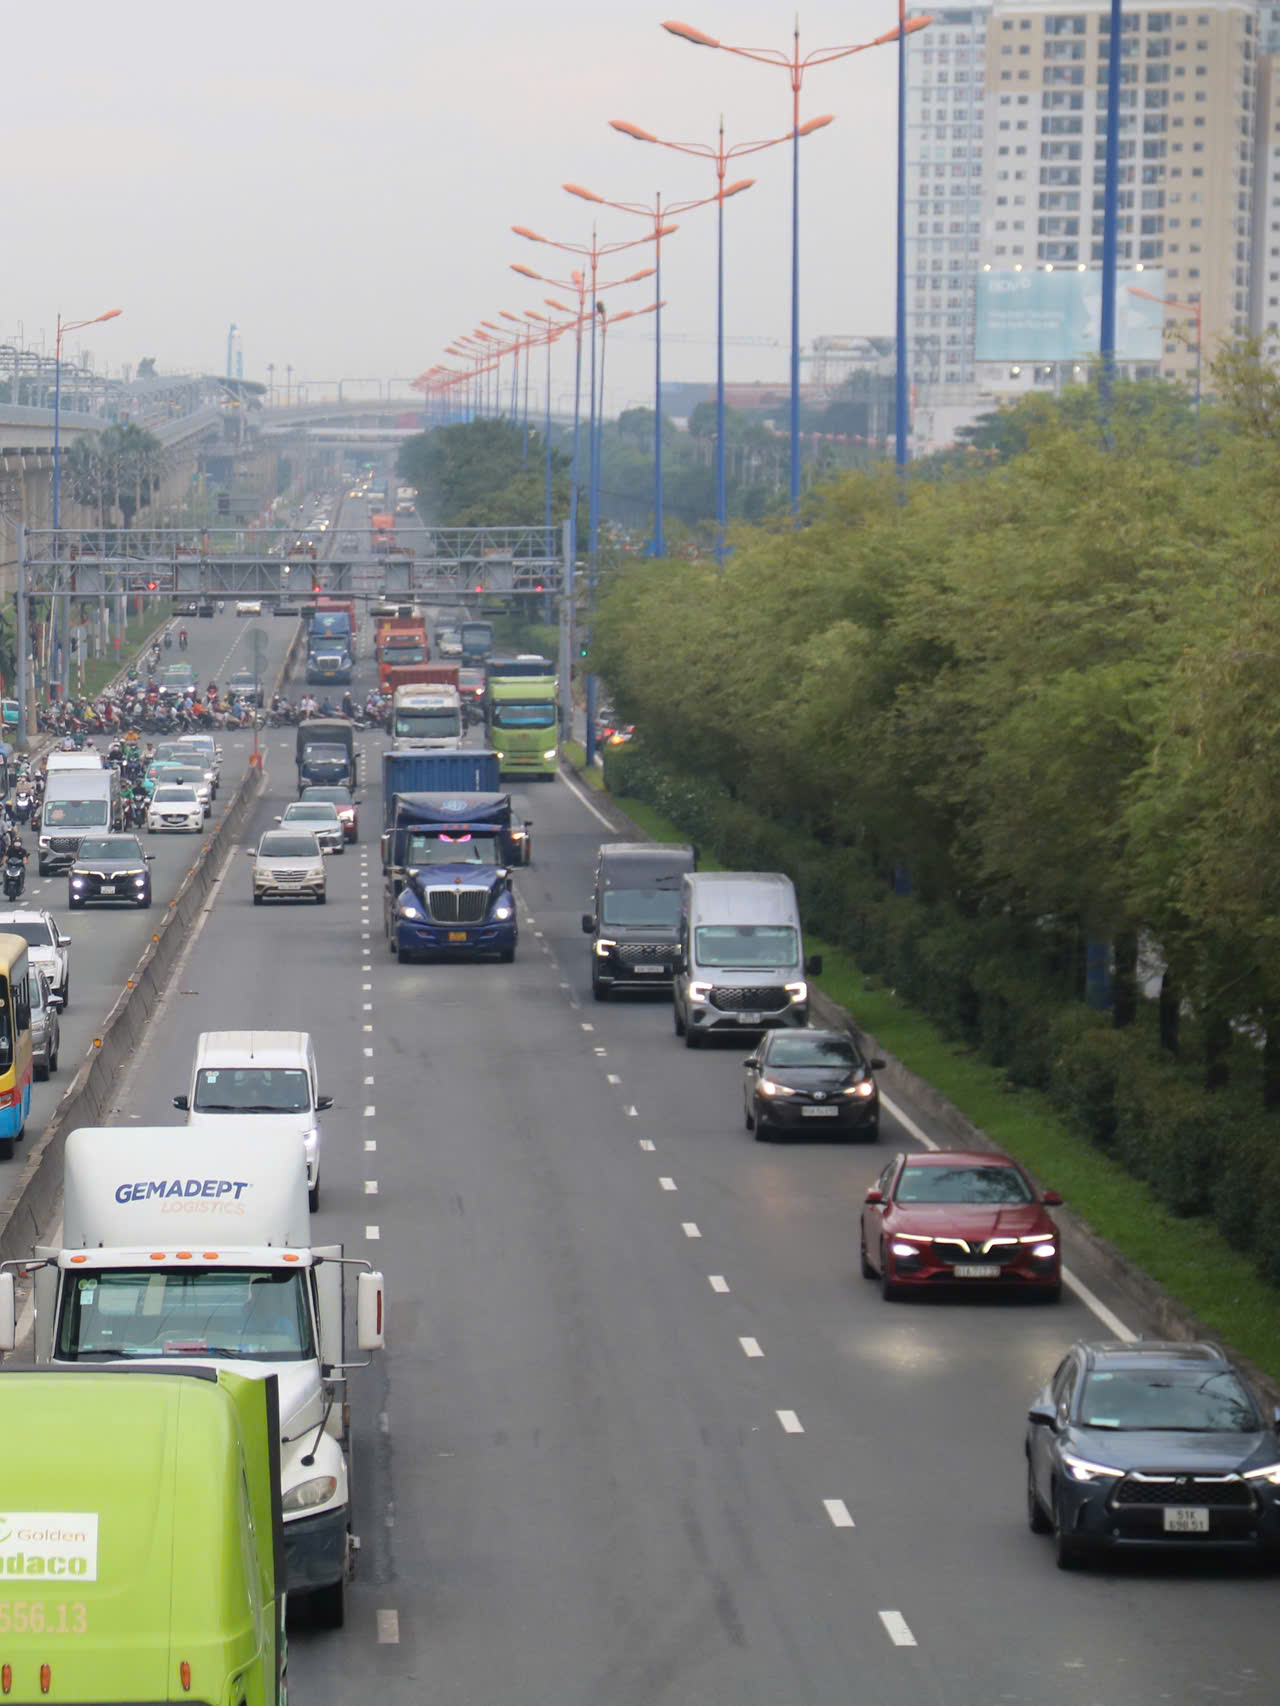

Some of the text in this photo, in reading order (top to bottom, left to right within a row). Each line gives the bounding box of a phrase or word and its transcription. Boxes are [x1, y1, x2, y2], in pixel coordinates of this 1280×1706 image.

[115, 1179, 248, 1204] GEMADEPT
[160, 1199, 245, 1216] LOGISTICS
[17, 1529, 88, 1543] Golden
